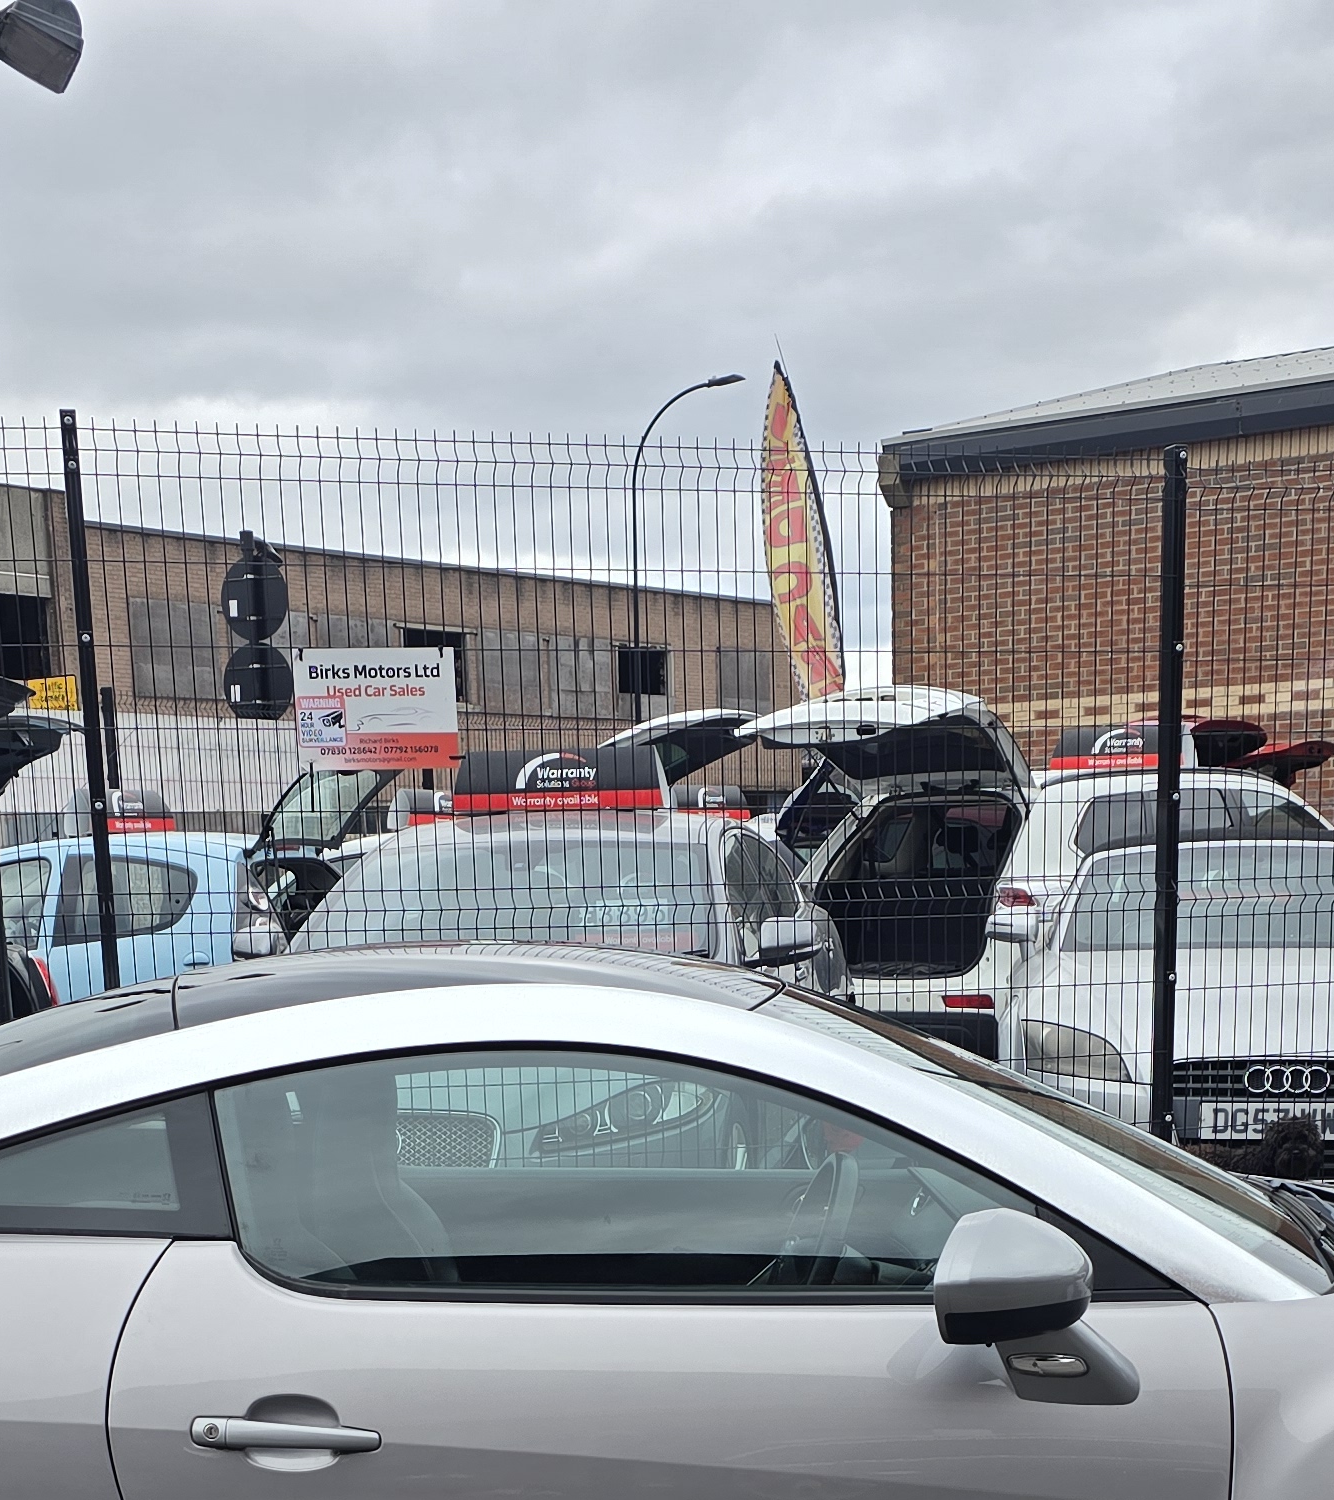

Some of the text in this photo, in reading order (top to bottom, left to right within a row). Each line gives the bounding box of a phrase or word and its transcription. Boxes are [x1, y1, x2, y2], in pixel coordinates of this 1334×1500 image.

[308, 663, 440, 680] Birks Motors Ltd
[326, 684, 425, 698] Used Car Sales
[299, 698, 341, 709] WARNING
[299, 711, 313, 721] 24
[301, 729, 323, 737] VIDEO
[320, 747, 347, 756] 07830
[348, 746, 377, 755] 128642
[383, 746, 408, 754] 07792
[410, 745, 439, 753] 156078
[536, 766, 597, 780] Warranty
[512, 794, 599, 808] Warranty available
